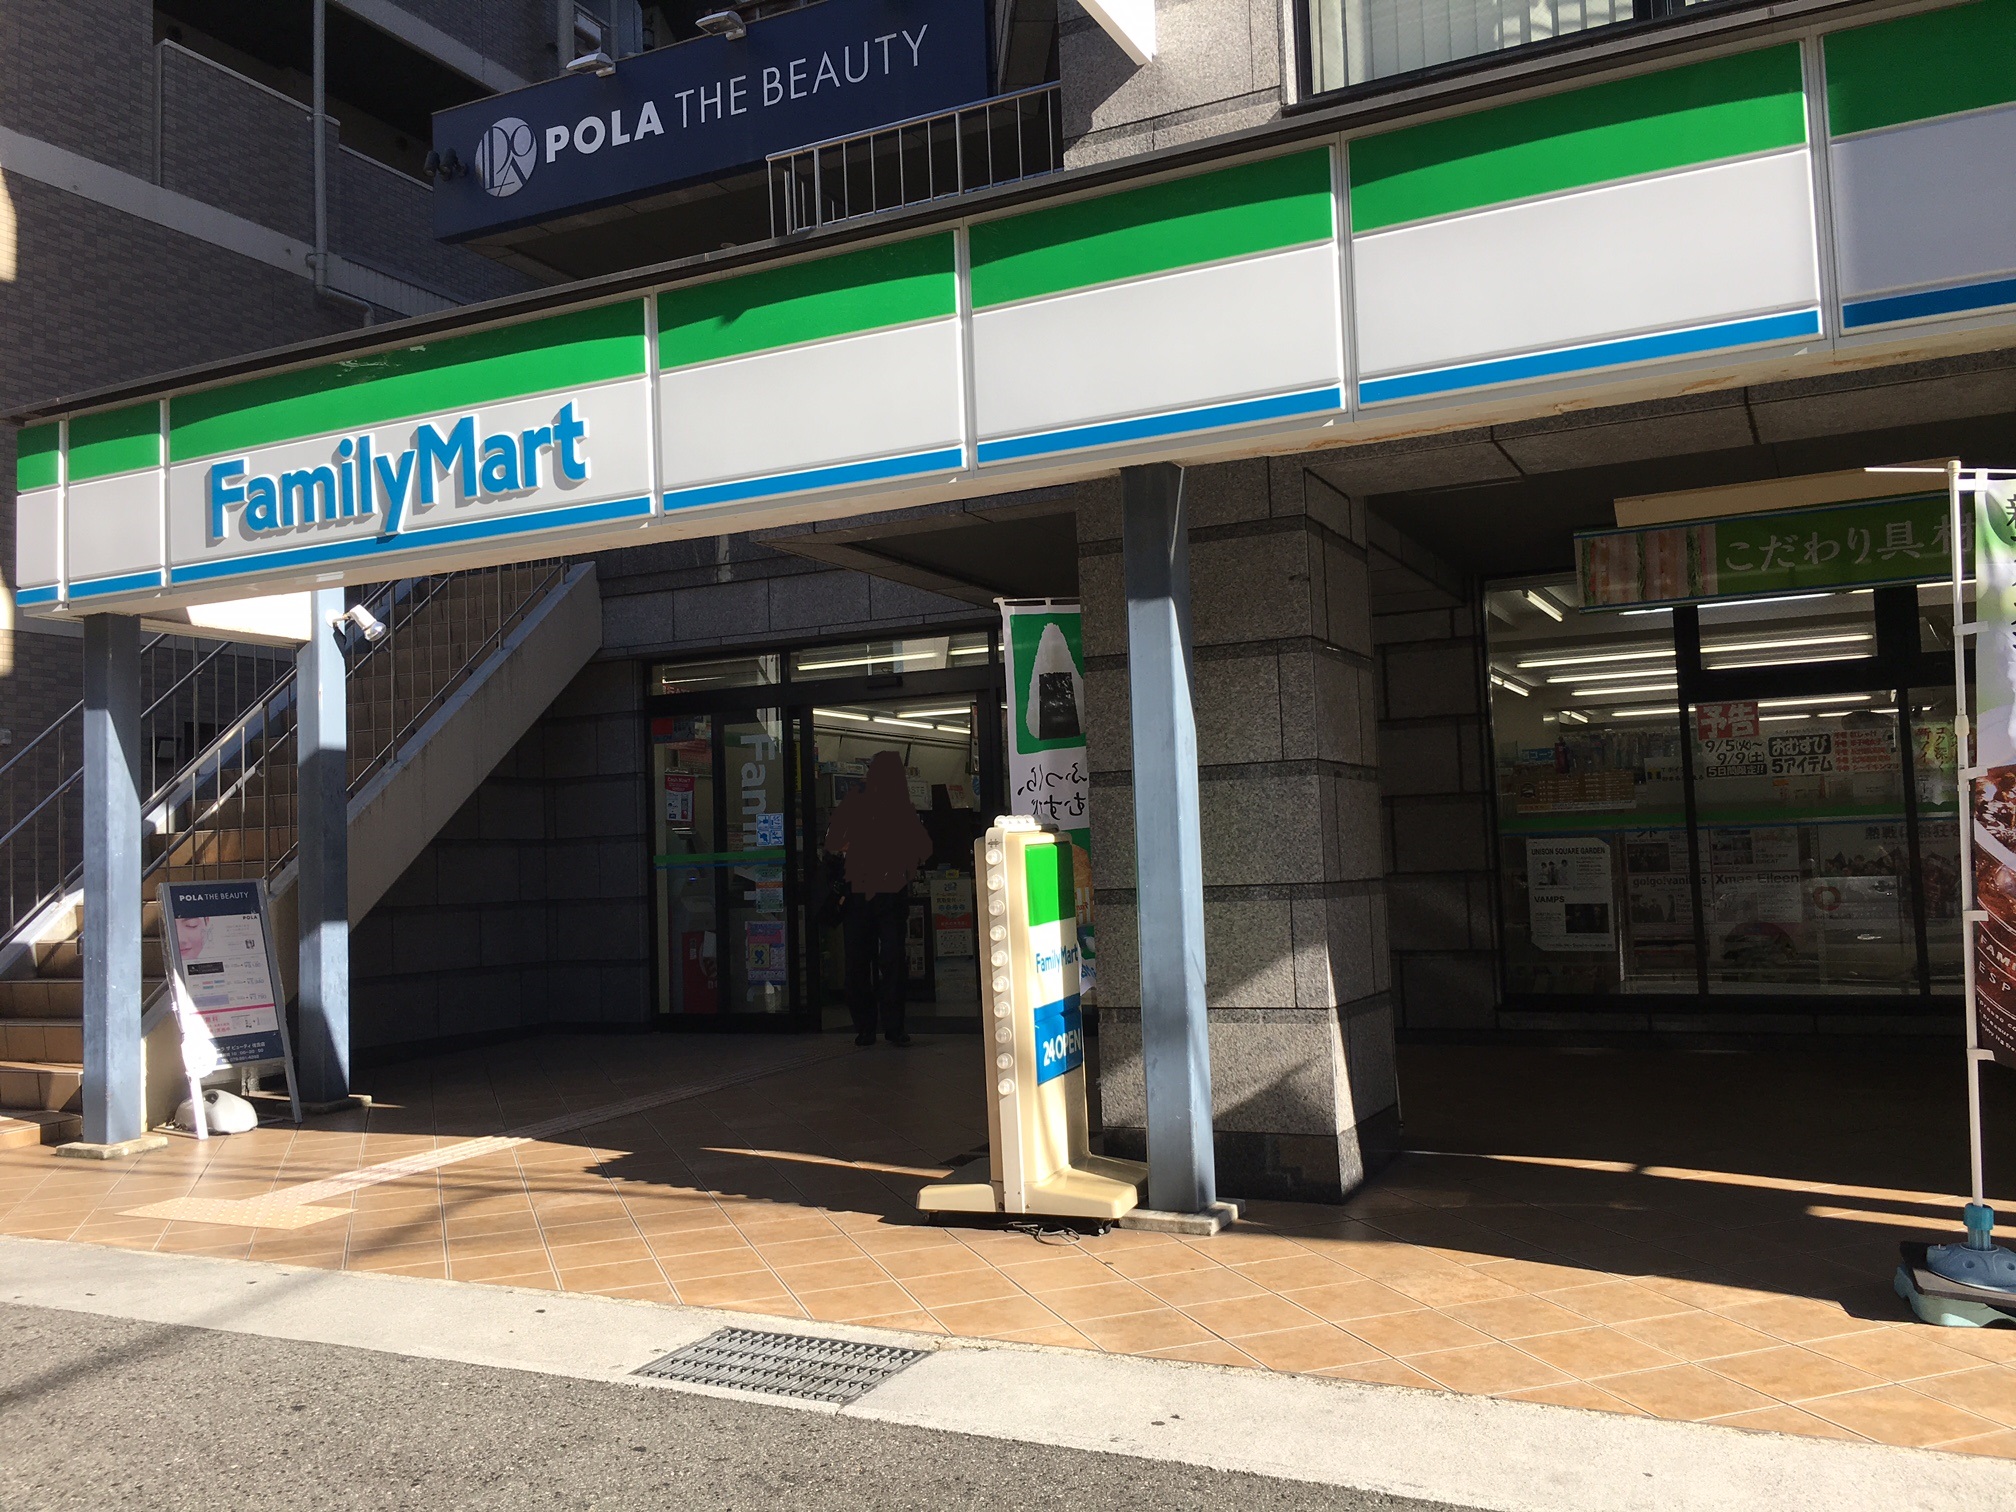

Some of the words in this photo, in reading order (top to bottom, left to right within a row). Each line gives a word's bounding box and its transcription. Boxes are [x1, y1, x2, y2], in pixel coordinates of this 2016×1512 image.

[545, 100, 665, 165] POLA
[675, 75, 748, 129] THE
[762, 23, 930, 108] BEAUTY
[206, 401, 590, 541] FamilyMart
[1724, 511, 1973, 573] こだわり具材
[1700, 703, 1756, 738] 予告
[1771, 735, 1828, 755] おむすび
[1716, 751, 1765, 766] 9/9(土)
[1771, 756, 1833, 774] 5アイテム
[1531, 848, 1554, 856] UNISON
[1555, 847, 1580, 855] SQUARE
[1581, 846, 1606, 854] GARDEN
[1715, 874, 1752, 885] Xmas
[1757, 873, 1799, 883] Eileen
[179, 894, 203, 902] POLA
[204, 893, 219, 901] THE
[220, 891, 249, 900] BEAUTY
[1533, 895, 1564, 903] VAMPS
[1036, 943, 1079, 974] FamilyMart
